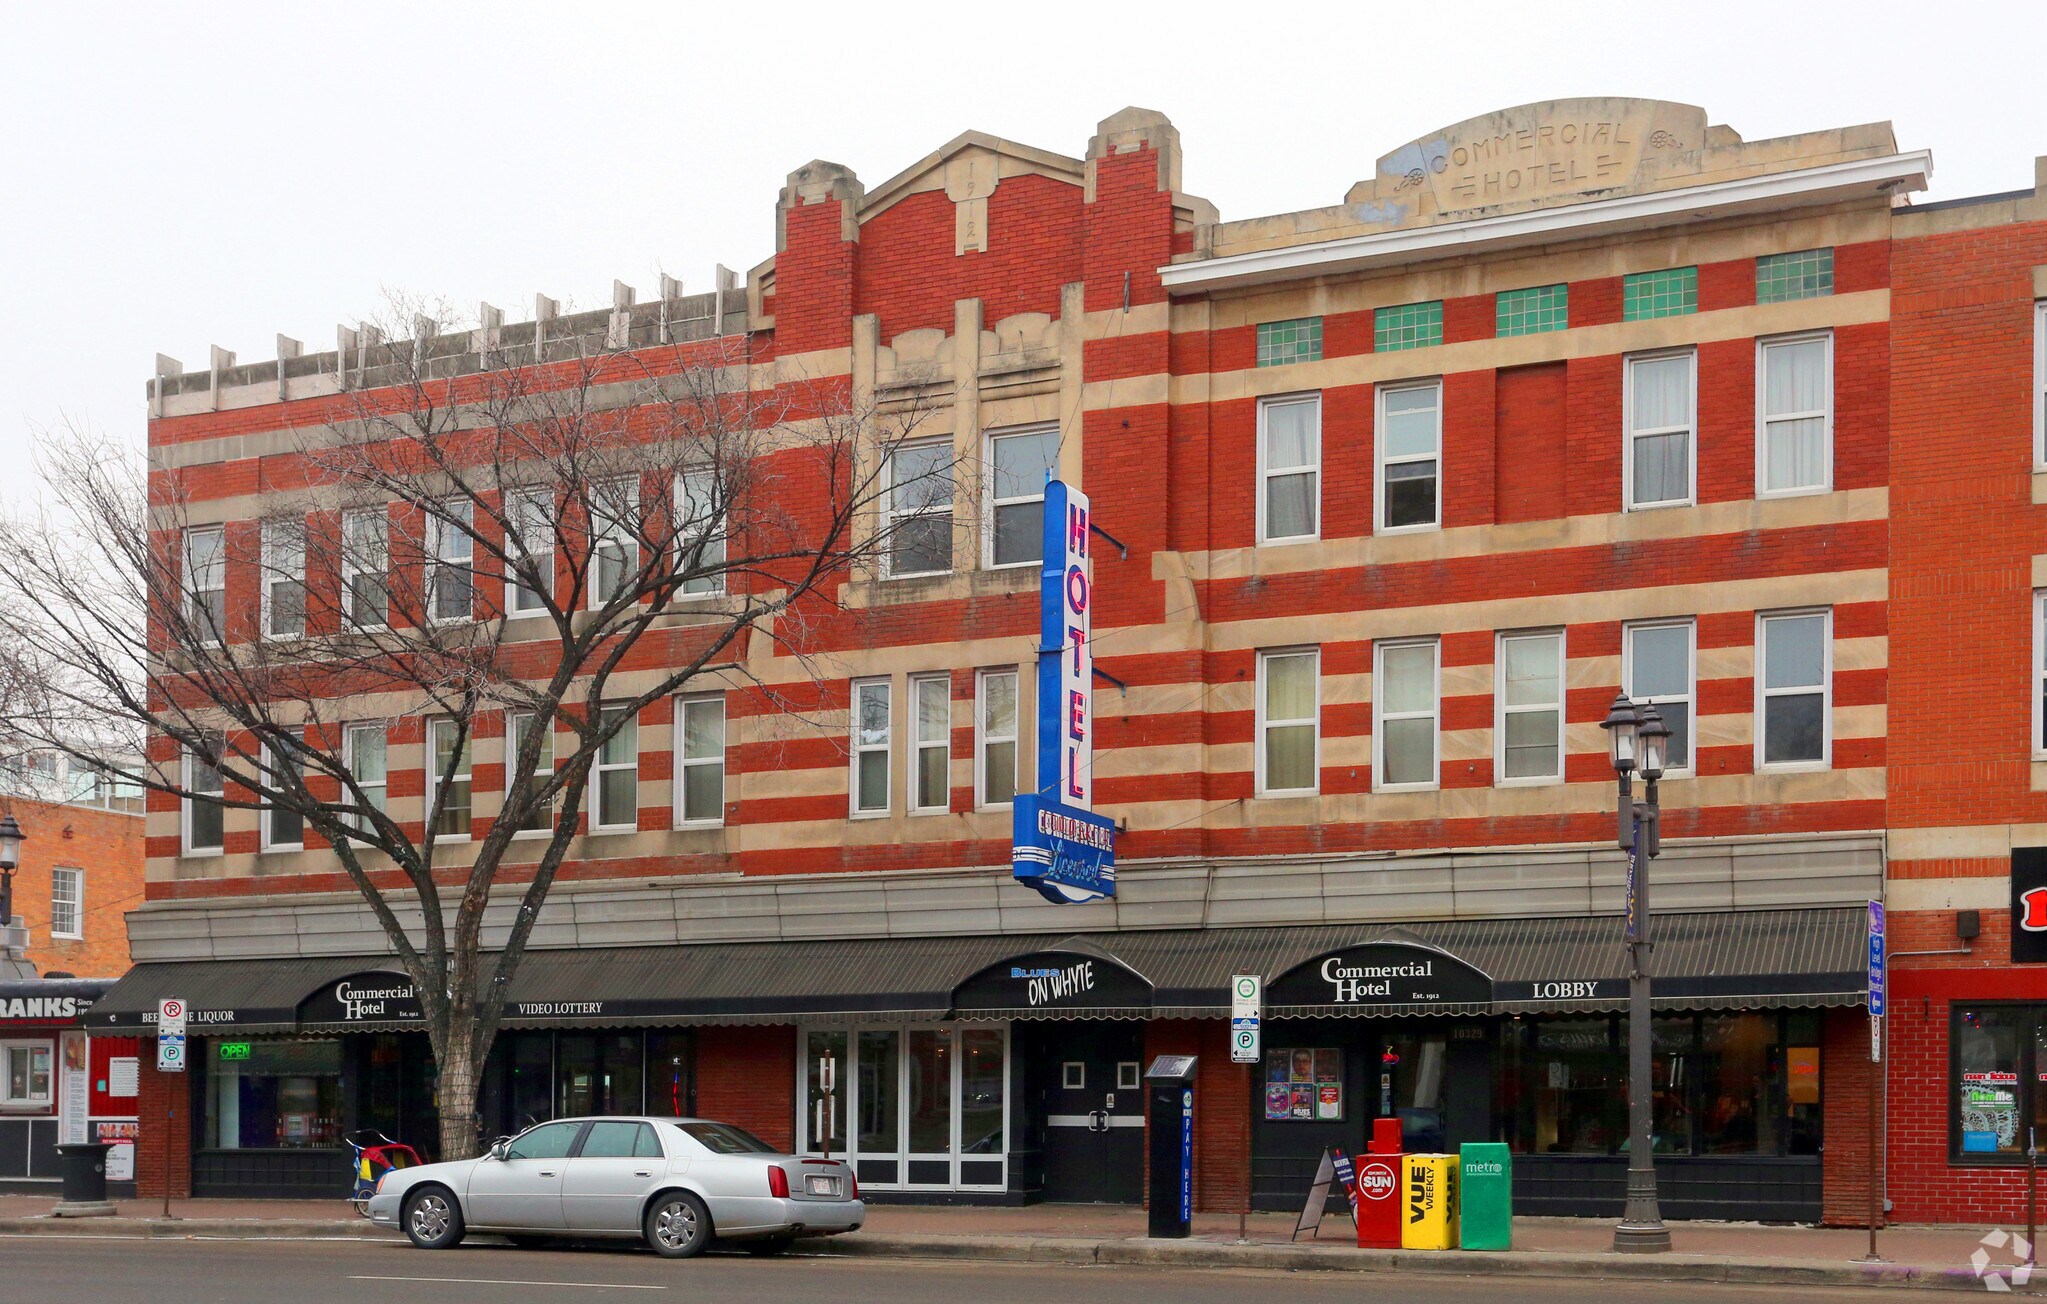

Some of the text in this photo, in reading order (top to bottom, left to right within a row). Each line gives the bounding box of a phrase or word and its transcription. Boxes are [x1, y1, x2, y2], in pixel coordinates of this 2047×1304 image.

[1430, 122, 1631, 175] COMMERCIAL
[1484, 160, 1588, 195] HOTEL
[1066, 503, 1090, 800] HOTEL
[1037, 809, 1113, 852] COMMERCIAL
[1320, 957, 1433, 983] Commercial
[335, 981, 414, 1004] Commercial
[1028, 960, 1095, 1006] ON WHYTE
[1333, 979, 1391, 1002] Hotel
[1532, 981, 1599, 998] LOBBY
[142, 1012, 159, 1023] BEE
[198, 1010, 235, 1024] LIQUOR
[344, 1000, 385, 1020] Hotel
[518, 1002, 603, 1015] VIDEO LOTTERY
[1453, 1028, 1483, 1039] 10329
[219, 1043, 251, 1059] OPEN
[1466, 1162, 1503, 1173] metro
[1363, 1176, 1392, 1188] SUN
[1410, 1166, 1426, 1225] VUE
[1426, 1167, 1435, 1211] WEEKLY
